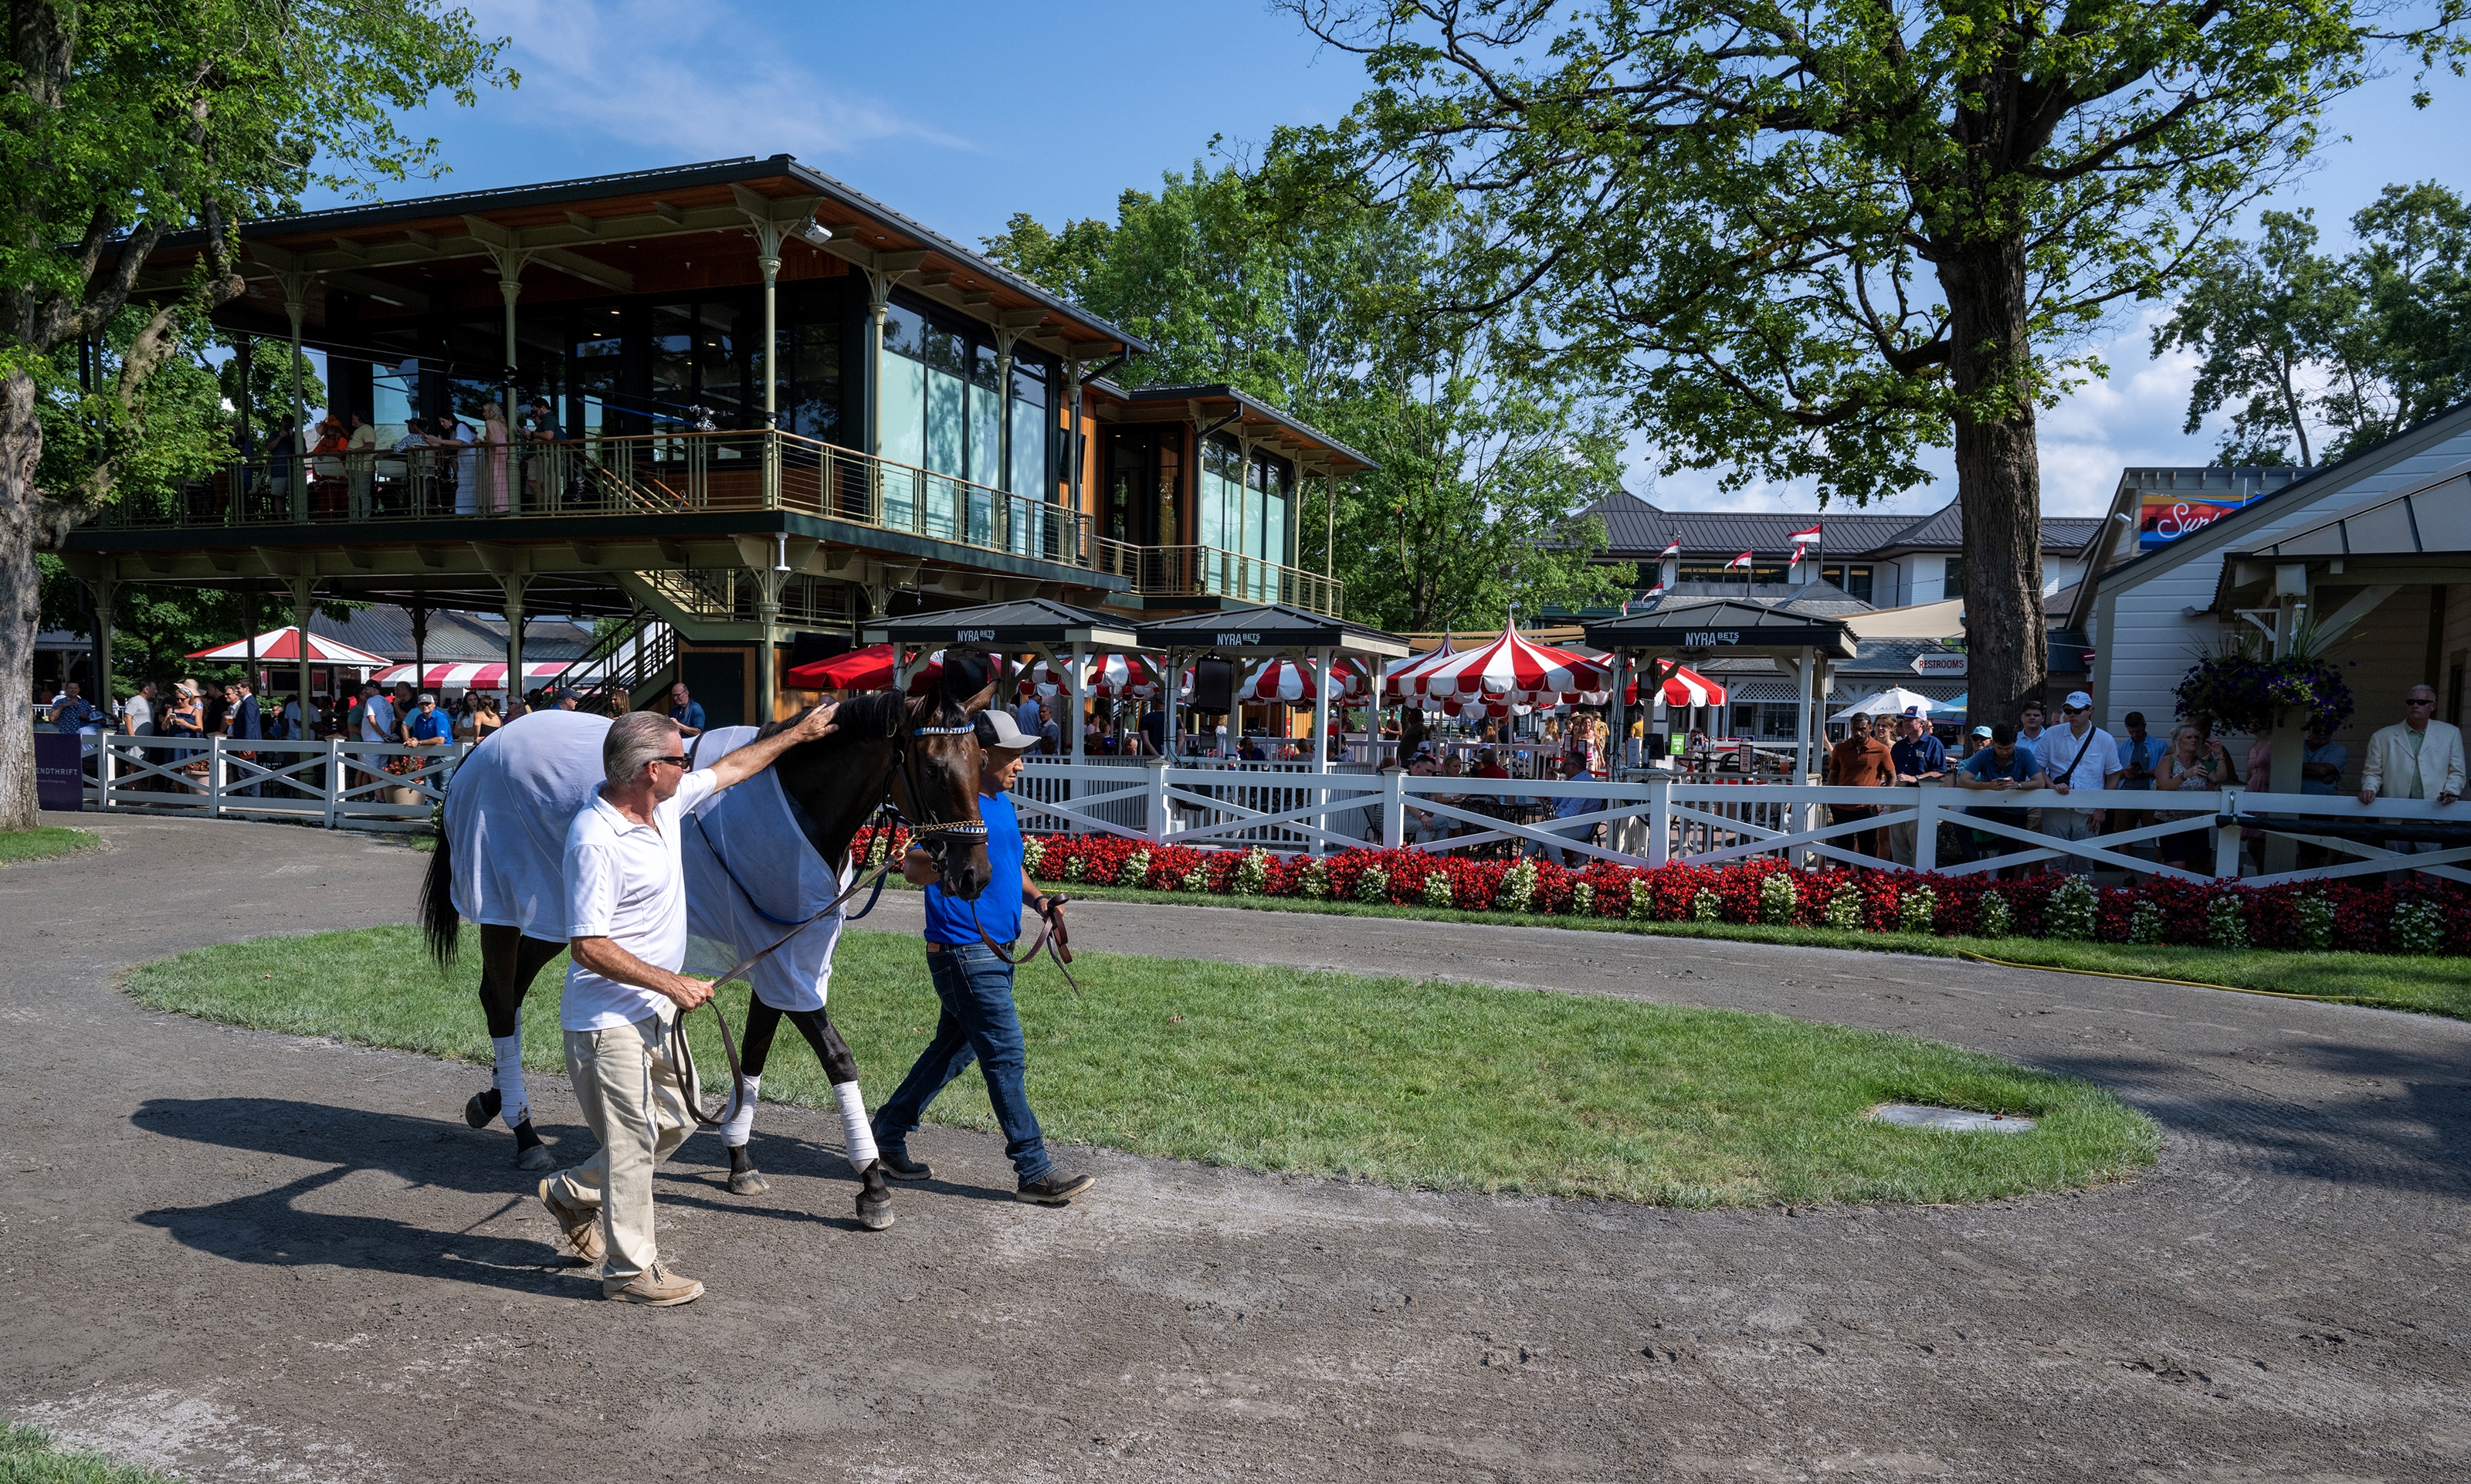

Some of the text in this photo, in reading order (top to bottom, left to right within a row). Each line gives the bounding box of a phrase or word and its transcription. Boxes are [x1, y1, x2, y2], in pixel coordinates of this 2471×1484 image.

[958, 630, 980, 642] NYRA
[1217, 633, 1242, 645] NYRA
[1685, 632, 1717, 645] NYRA
[1919, 659, 1964, 669] RESTROOMS
